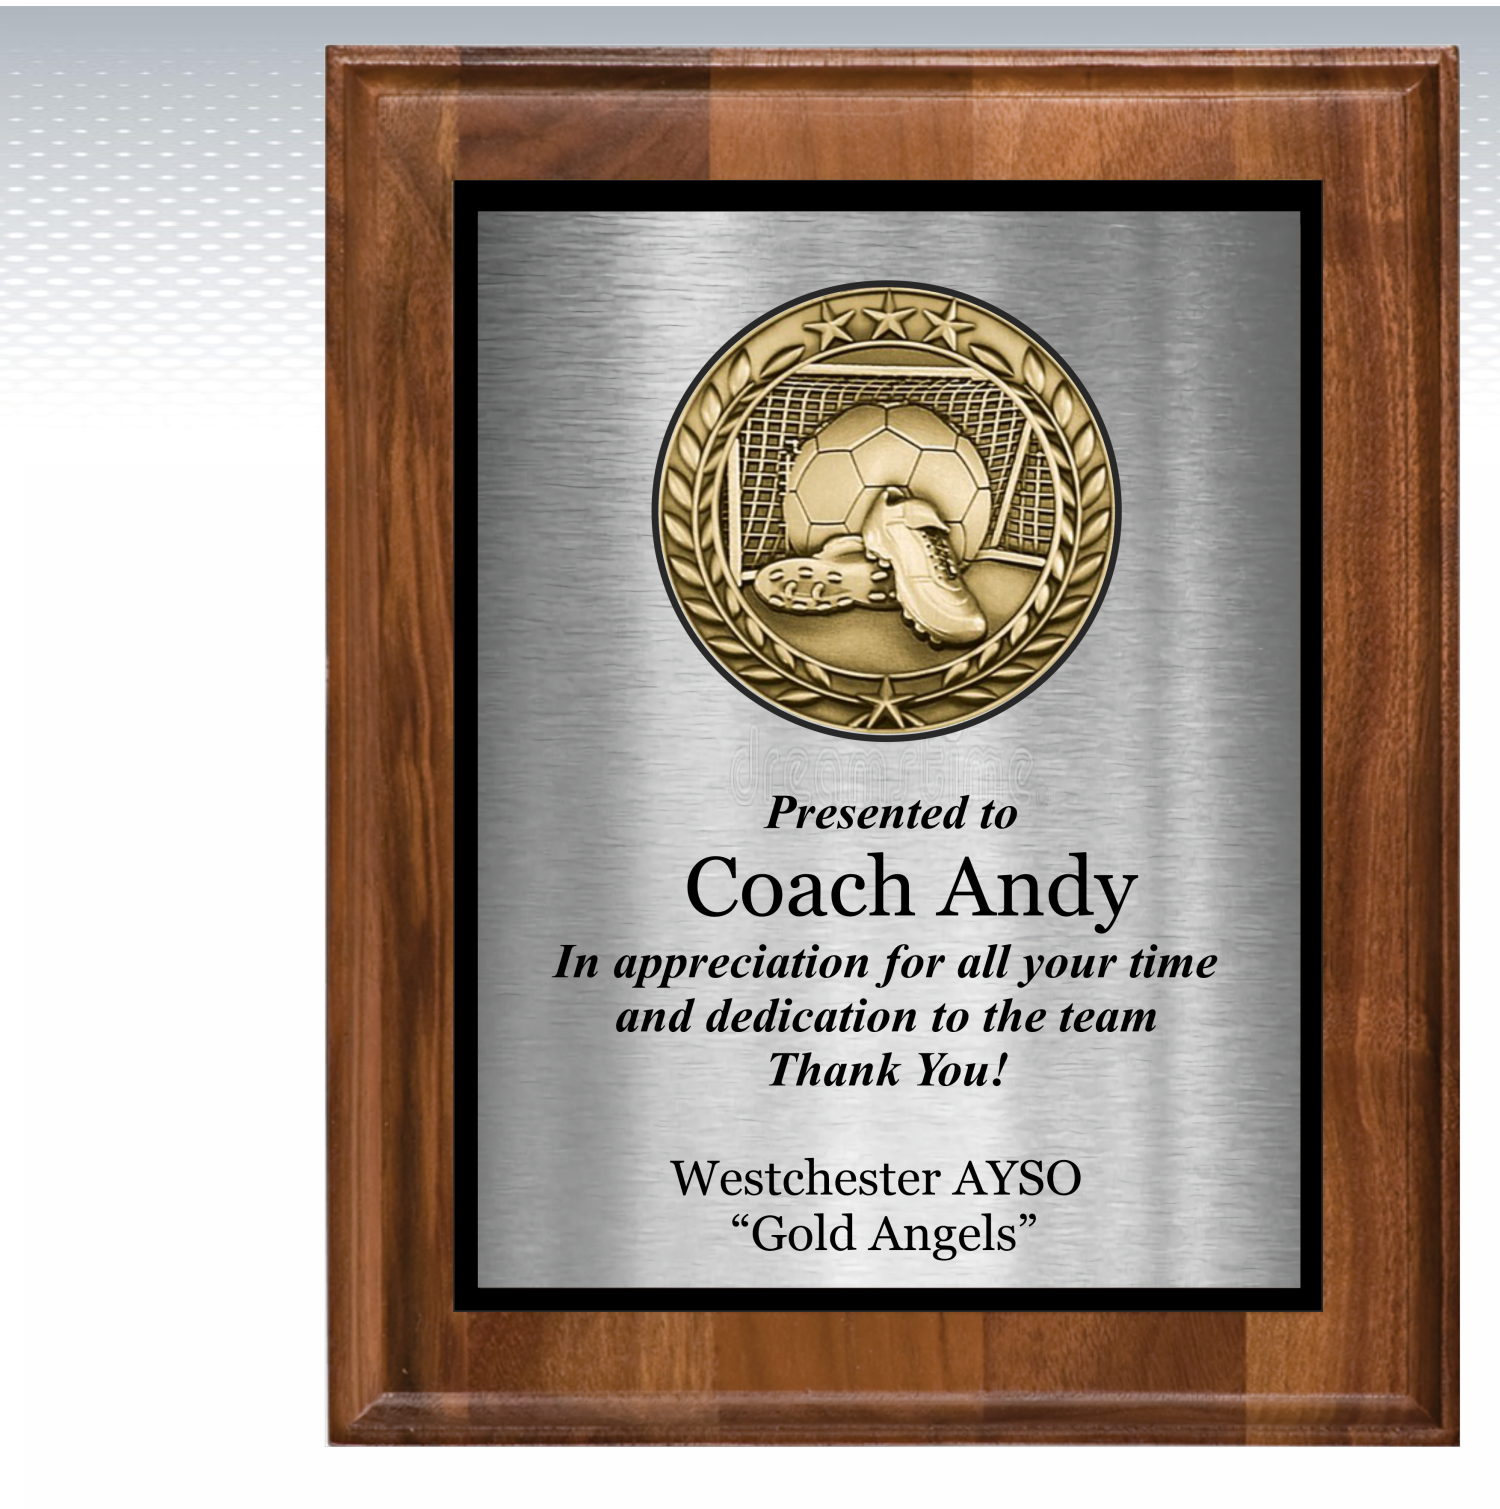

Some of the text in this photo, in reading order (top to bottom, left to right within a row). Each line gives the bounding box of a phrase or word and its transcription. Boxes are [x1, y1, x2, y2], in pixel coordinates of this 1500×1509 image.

[763, 793, 1018, 830] Presented to
[687, 851, 1139, 934] Coach Andy
[551, 943, 1218, 989] In appreciation for all your time
[615, 997, 1157, 1033] and dedication to the team
[770, 1052, 1008, 1087] Thank You!
[669, 1157, 1081, 1196] Westchester AYSO
[731, 1212, 1037, 1261] “Gold Angels”
